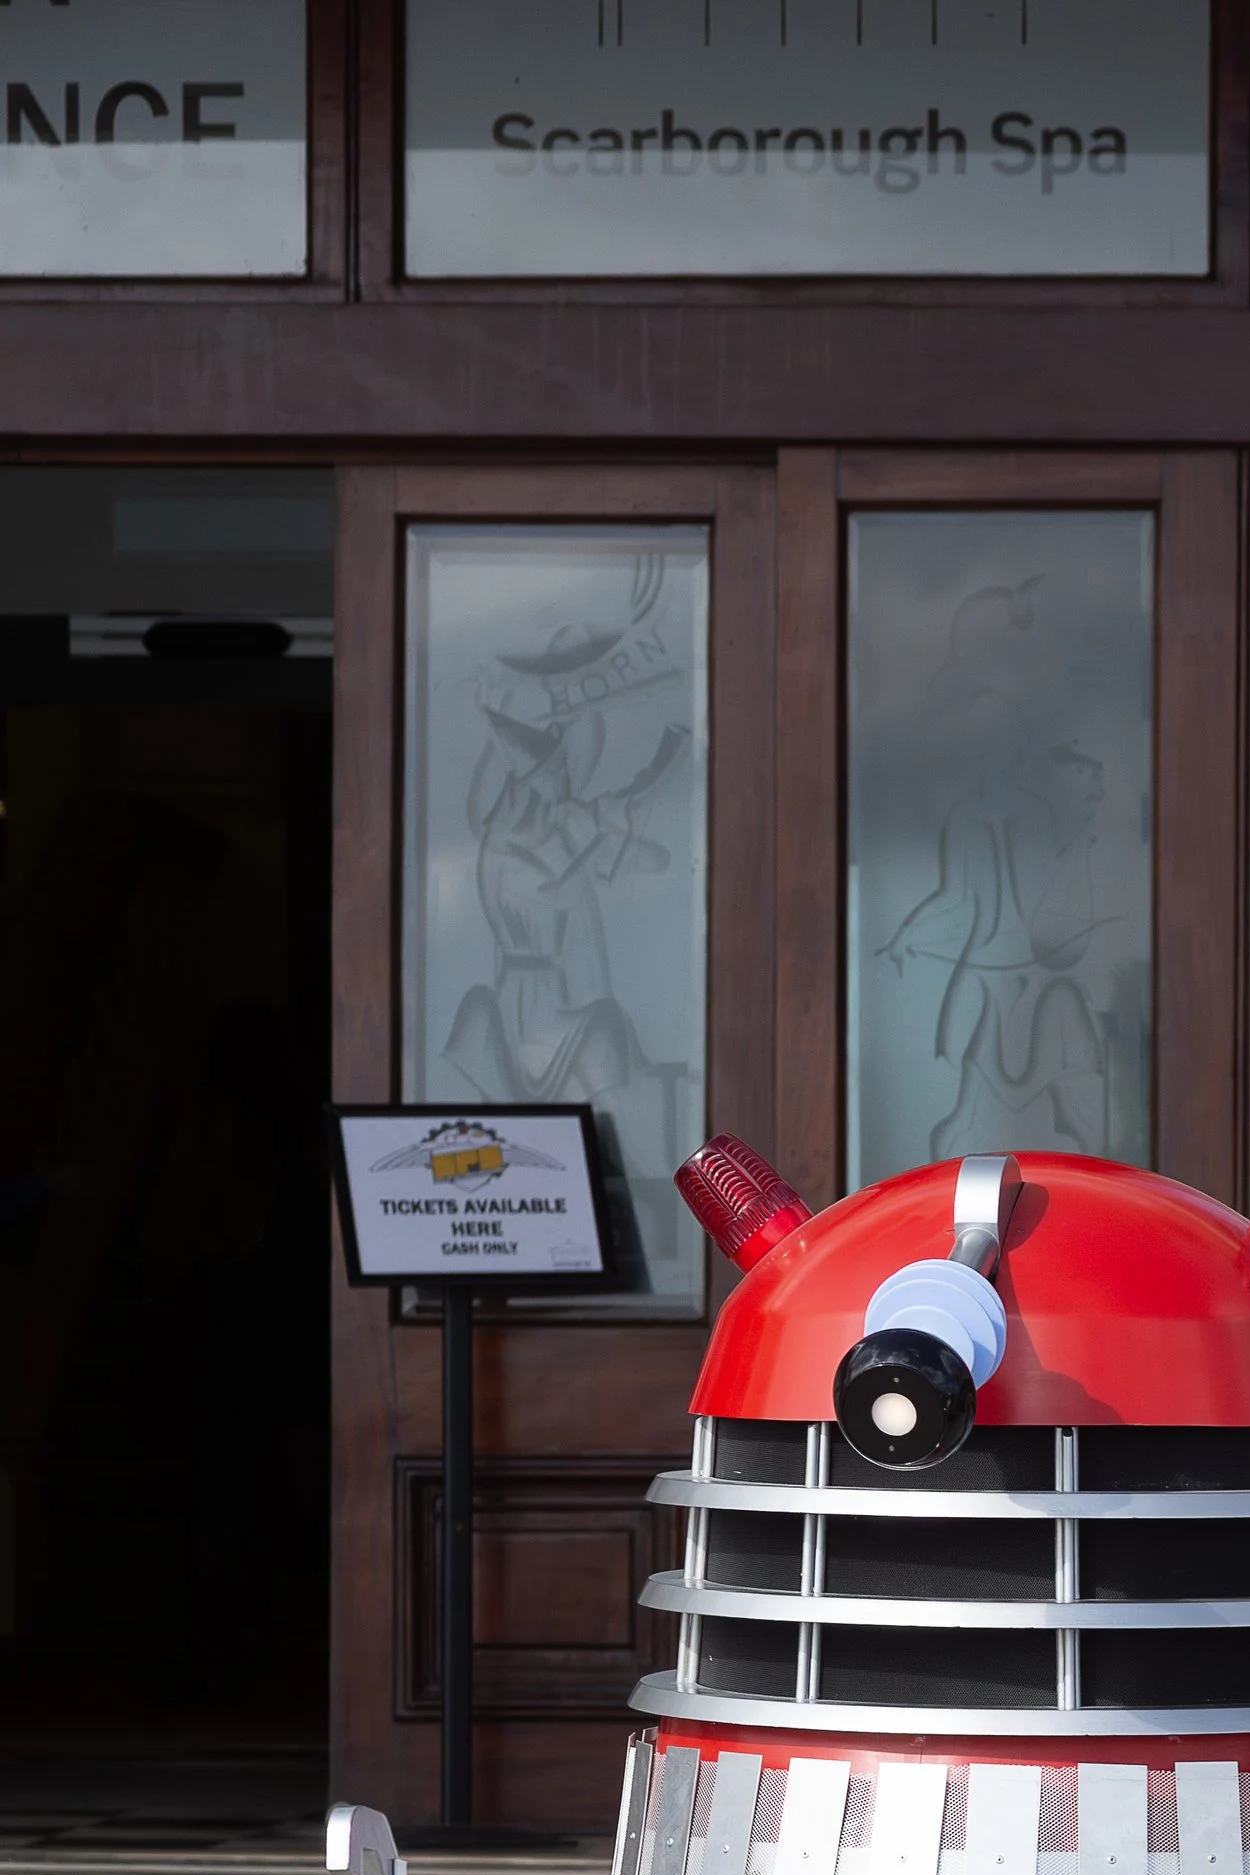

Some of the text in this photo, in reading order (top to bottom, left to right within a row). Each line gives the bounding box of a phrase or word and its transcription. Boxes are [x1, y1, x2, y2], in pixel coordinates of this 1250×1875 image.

[491, 108, 1128, 194] Scarborough Spa
[380, 1198, 567, 1215] TICKETS AVAILABLE
[451, 1221, 503, 1237] HERE
[441, 1241, 518, 1256] CASH ONLY
